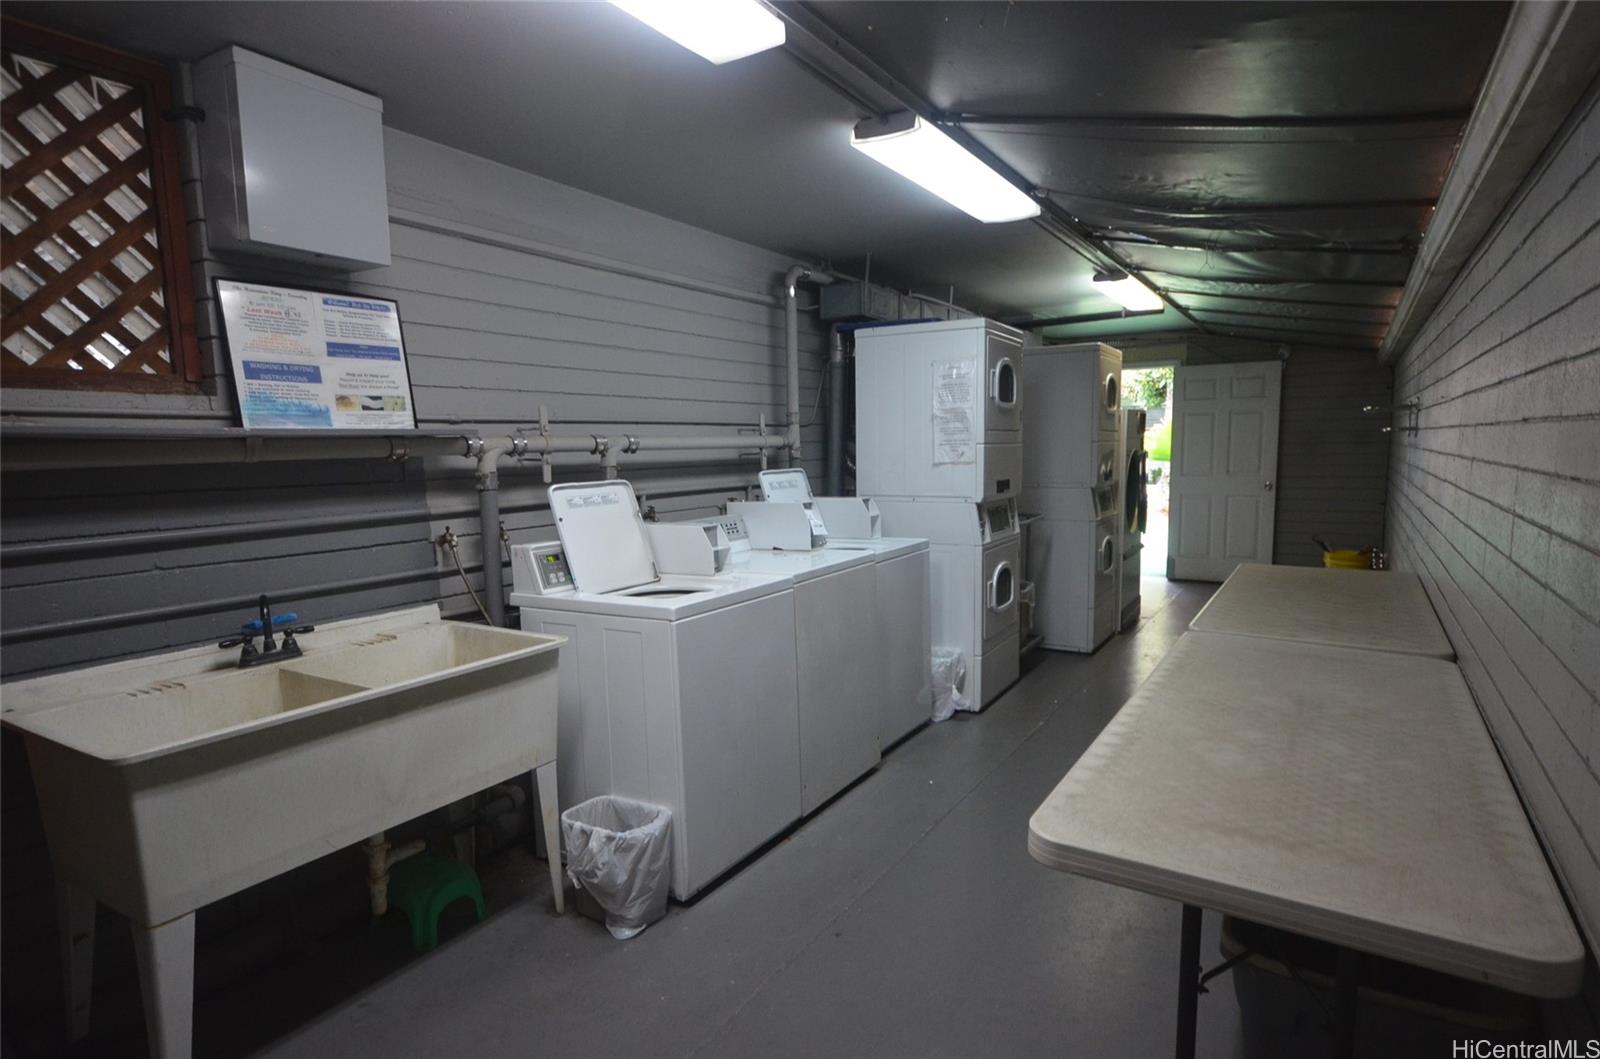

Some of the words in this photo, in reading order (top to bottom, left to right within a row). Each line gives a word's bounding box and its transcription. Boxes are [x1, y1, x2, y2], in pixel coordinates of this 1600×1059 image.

[249, 362, 282, 371] WASHING
[290, 365, 314, 373] DRYING
[259, 374, 309, 382] INSTRUCTIONS
